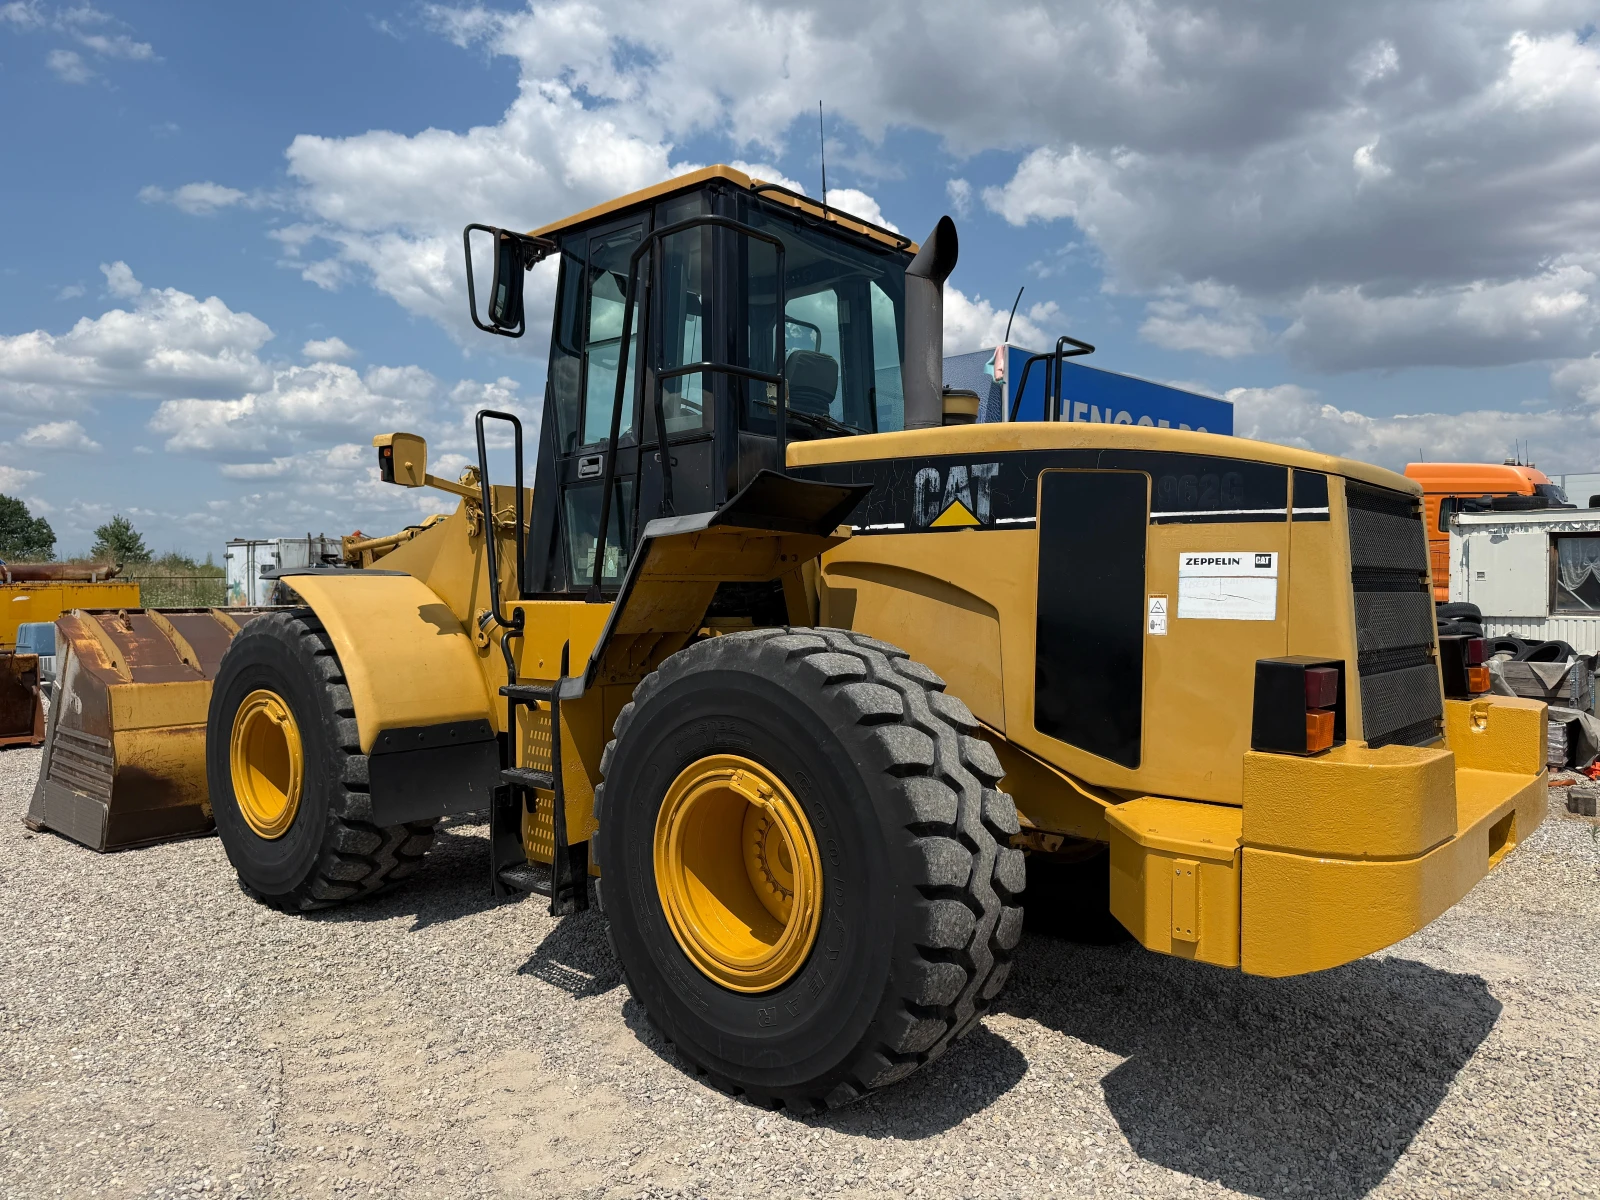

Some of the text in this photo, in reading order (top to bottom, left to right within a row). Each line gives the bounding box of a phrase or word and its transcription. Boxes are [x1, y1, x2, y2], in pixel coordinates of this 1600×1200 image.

[914, 463, 999, 527] CAT
[1158, 472, 1244, 508] 962G
[1186, 556, 1271, 566] ZEPPELIN CAT
